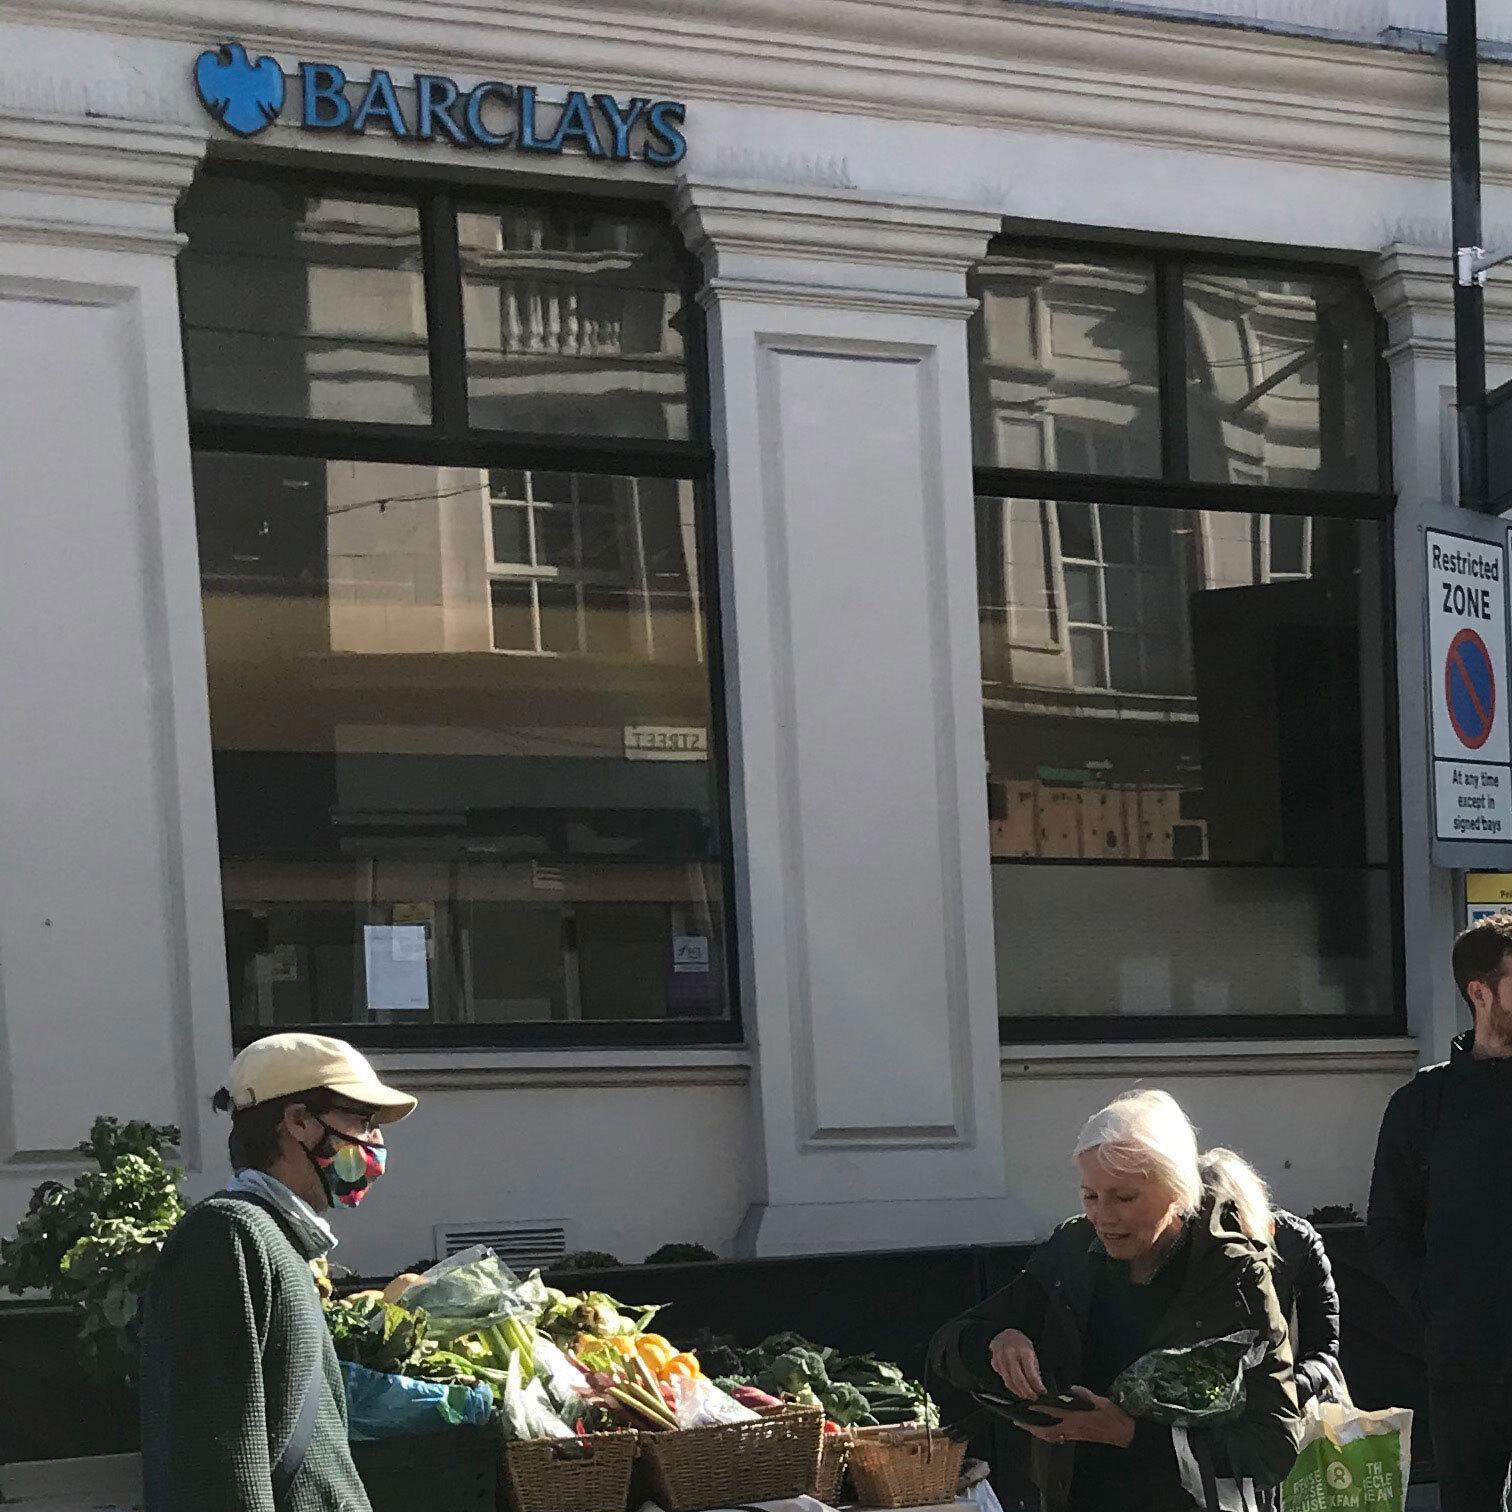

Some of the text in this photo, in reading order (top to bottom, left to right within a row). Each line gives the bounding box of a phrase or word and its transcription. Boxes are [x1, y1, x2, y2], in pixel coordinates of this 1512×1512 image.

[299, 62, 687, 168] BARCLAYS
[1432, 544, 1499, 581] Restricted
[1442, 582, 1491, 620] ZONE
[1452, 769, 1463, 785] At
[1500, 890, 1512, 899] Fri
